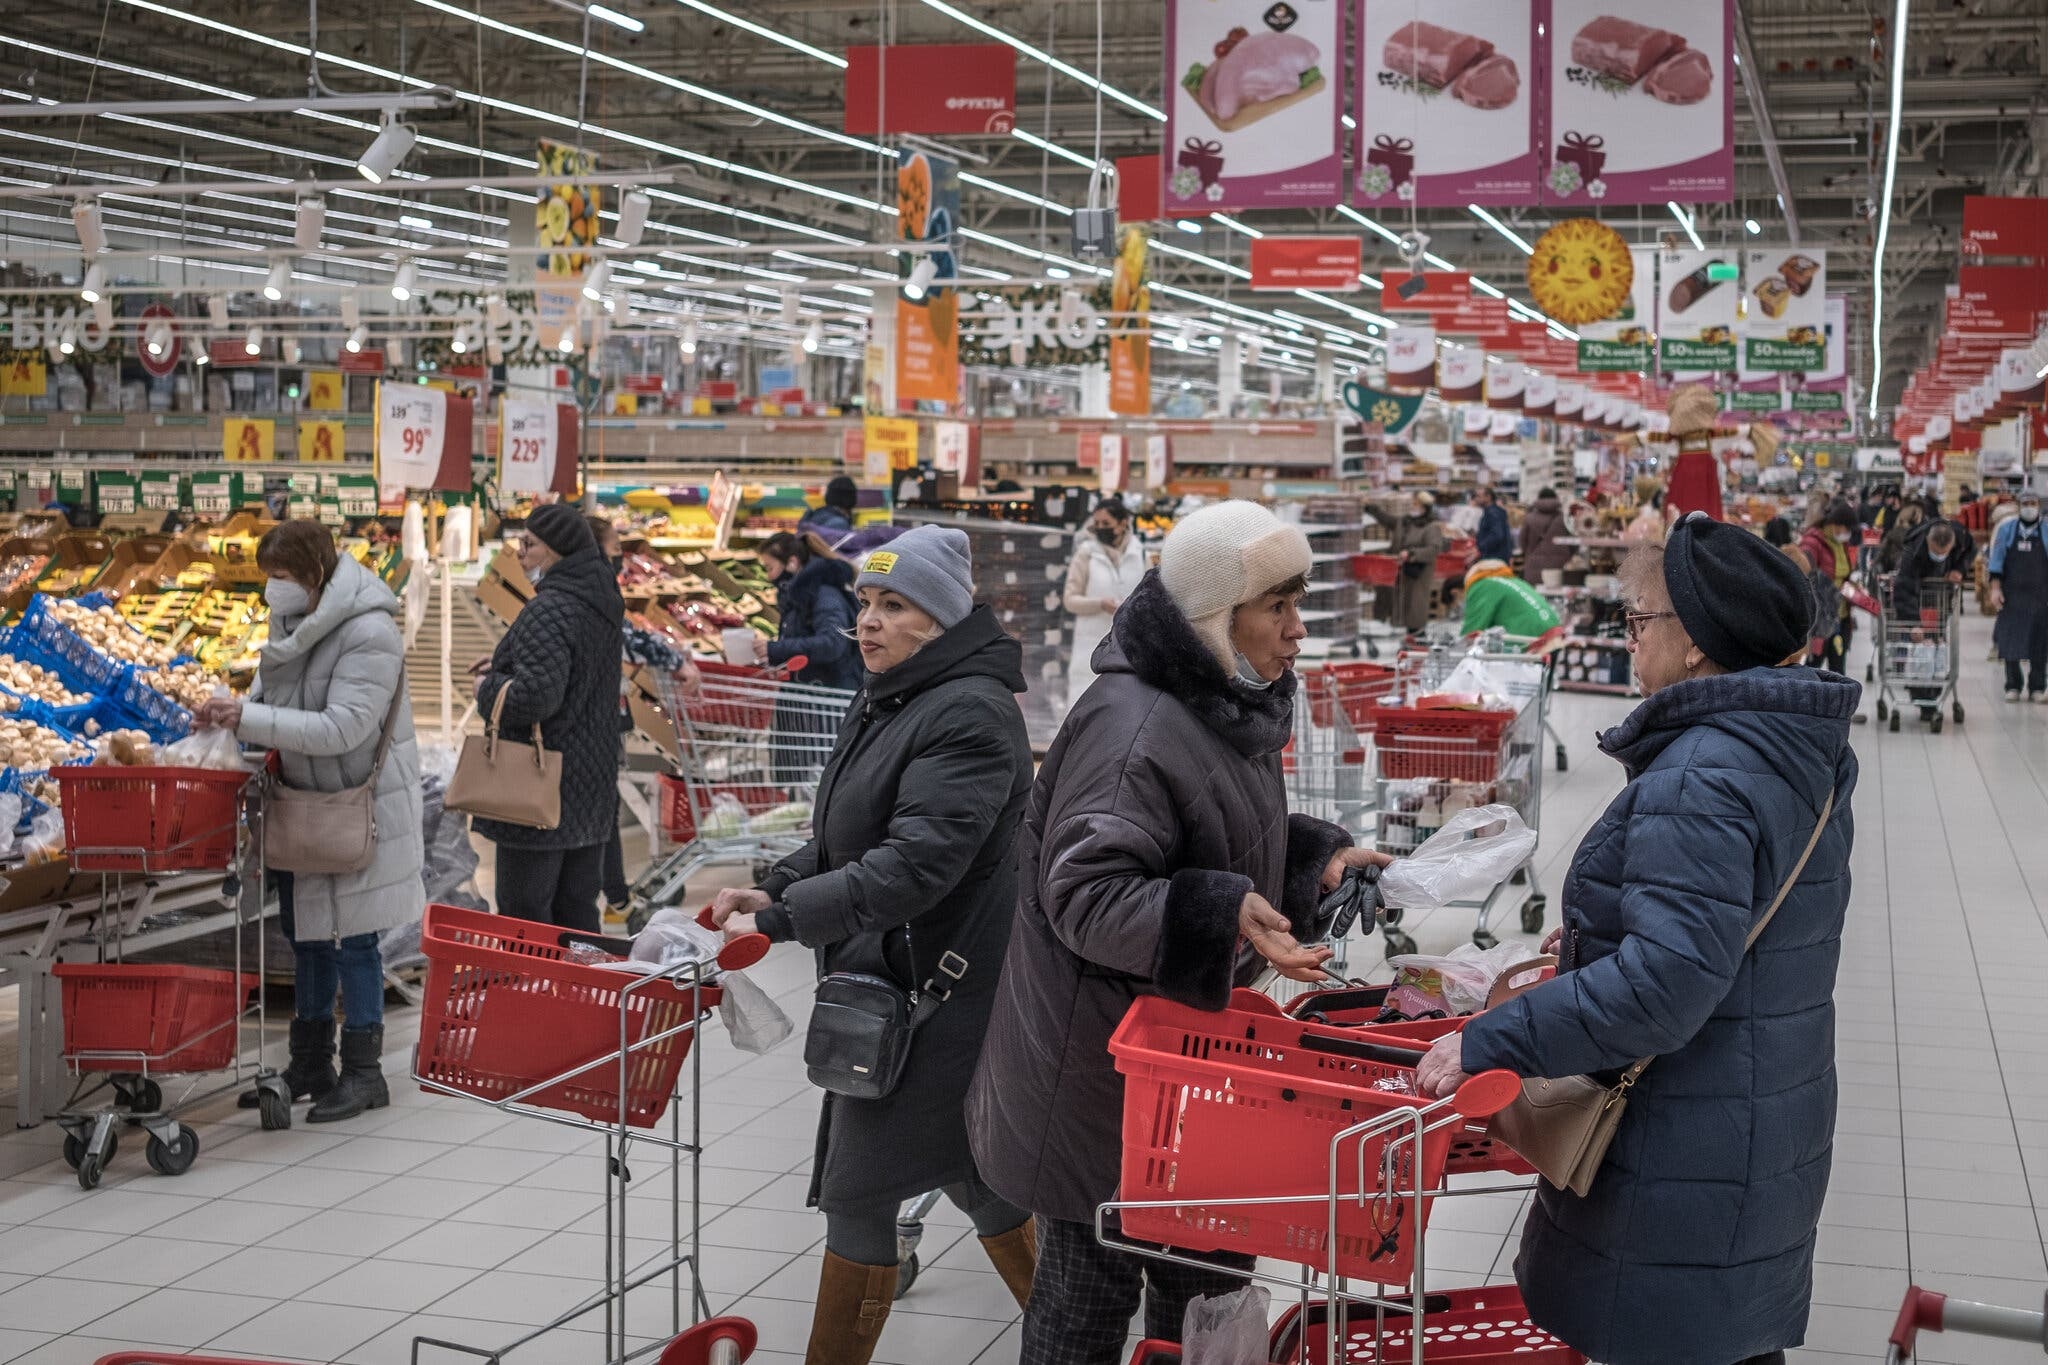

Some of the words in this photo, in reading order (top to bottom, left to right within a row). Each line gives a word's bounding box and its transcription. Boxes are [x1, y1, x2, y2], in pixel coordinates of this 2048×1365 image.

[945, 97, 1006, 110] ФРУКТЫ
[12, 306, 109, 352] БИО
[981, 300, 1097, 349] ЭКО
[402, 426, 424, 456] 99
[511, 437, 539, 463] 229
